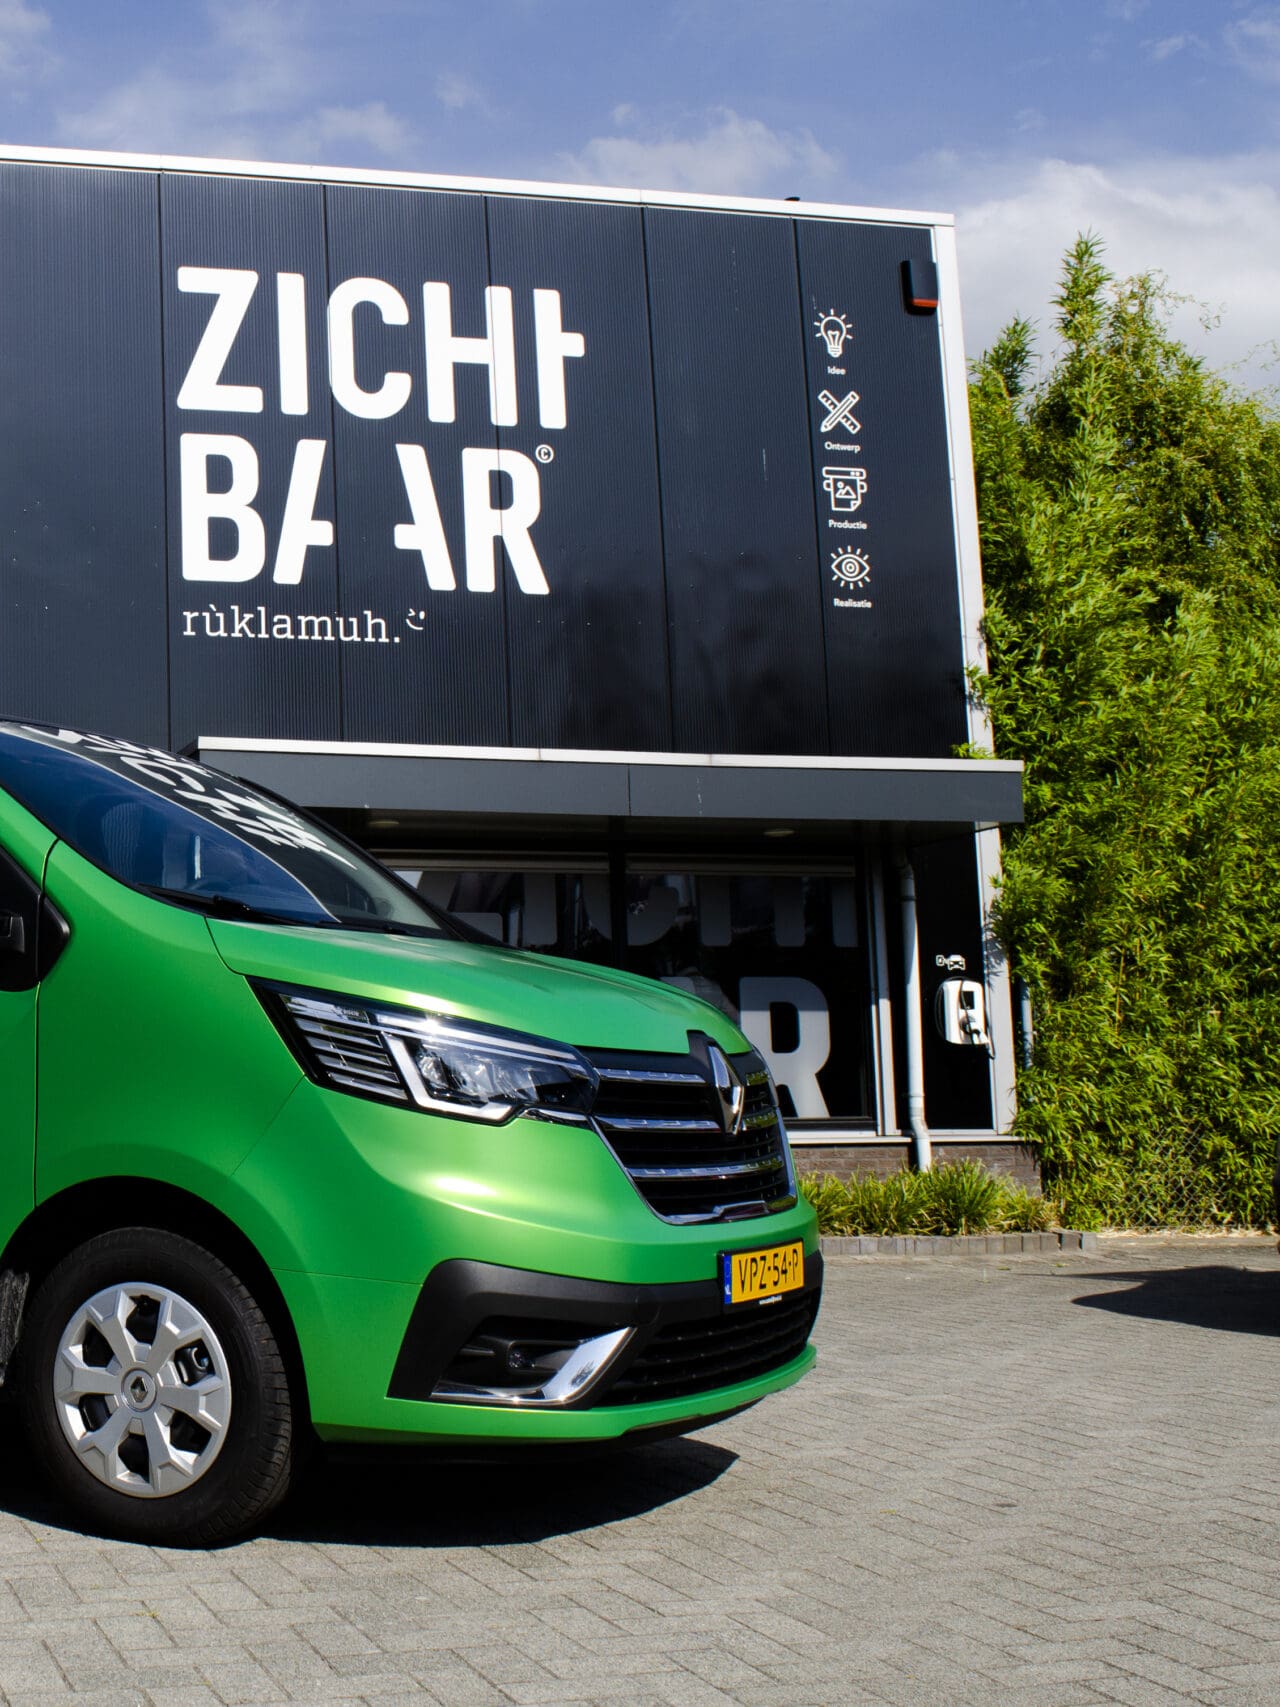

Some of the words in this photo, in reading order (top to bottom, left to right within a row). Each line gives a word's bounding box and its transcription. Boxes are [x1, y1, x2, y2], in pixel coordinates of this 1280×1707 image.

[826, 365, 847, 376] Idee
[823, 440, 862, 454] Ontwerp
[828, 518, 868, 530] Productie
[833, 597, 873, 609] Realisatie
[738, 1247, 800, 1294] VPZ-54-P
